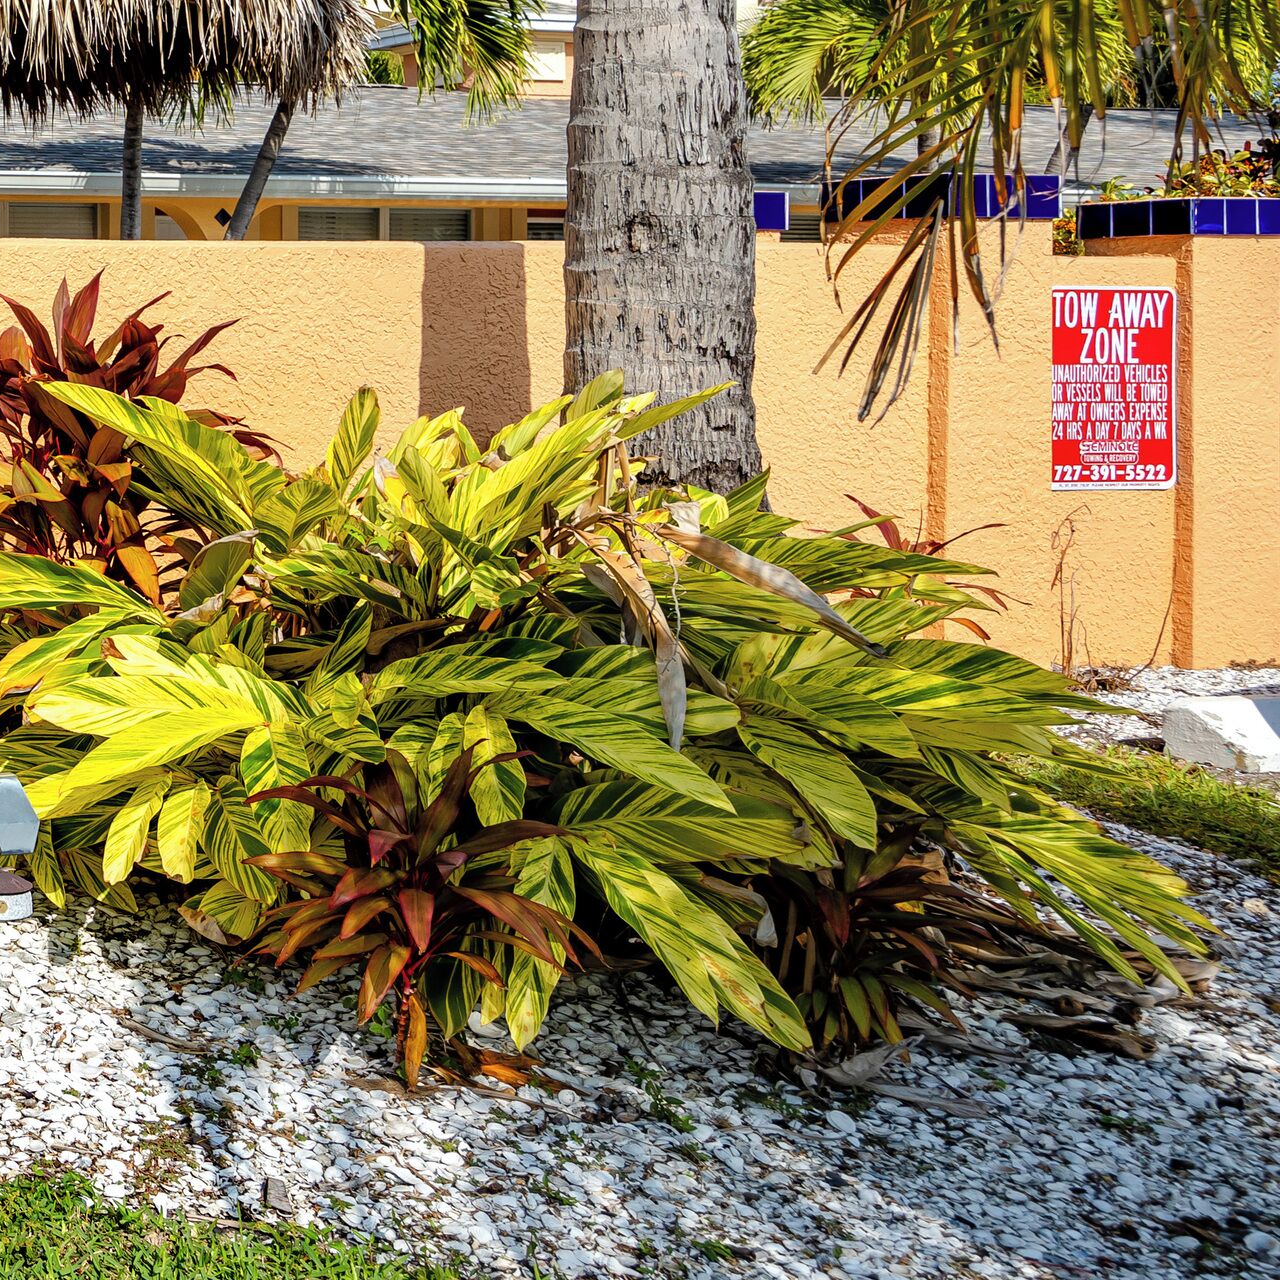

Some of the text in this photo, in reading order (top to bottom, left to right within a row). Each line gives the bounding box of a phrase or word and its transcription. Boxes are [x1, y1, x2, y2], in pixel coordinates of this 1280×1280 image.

[1052, 291, 1169, 328] TOW AWAY
[1080, 327, 1139, 364] ZONE
[1052, 364, 1168, 383] UNAUTHORIZED VEHICLES
[1052, 383, 1168, 402] OR VESSELS WILL BE TOWED
[1052, 402, 1168, 421] AWAY AT OWNERS EXPENSE
[1052, 421, 1167, 440] 24 HRS A DAY 7 DAYS A WK
[1079, 440, 1139, 453] SEMINOLE
[1083, 454, 1103, 462] TOWING
[1109, 454, 1136, 462] RECOVERY
[1054, 464, 1166, 481] 727-391-5522
